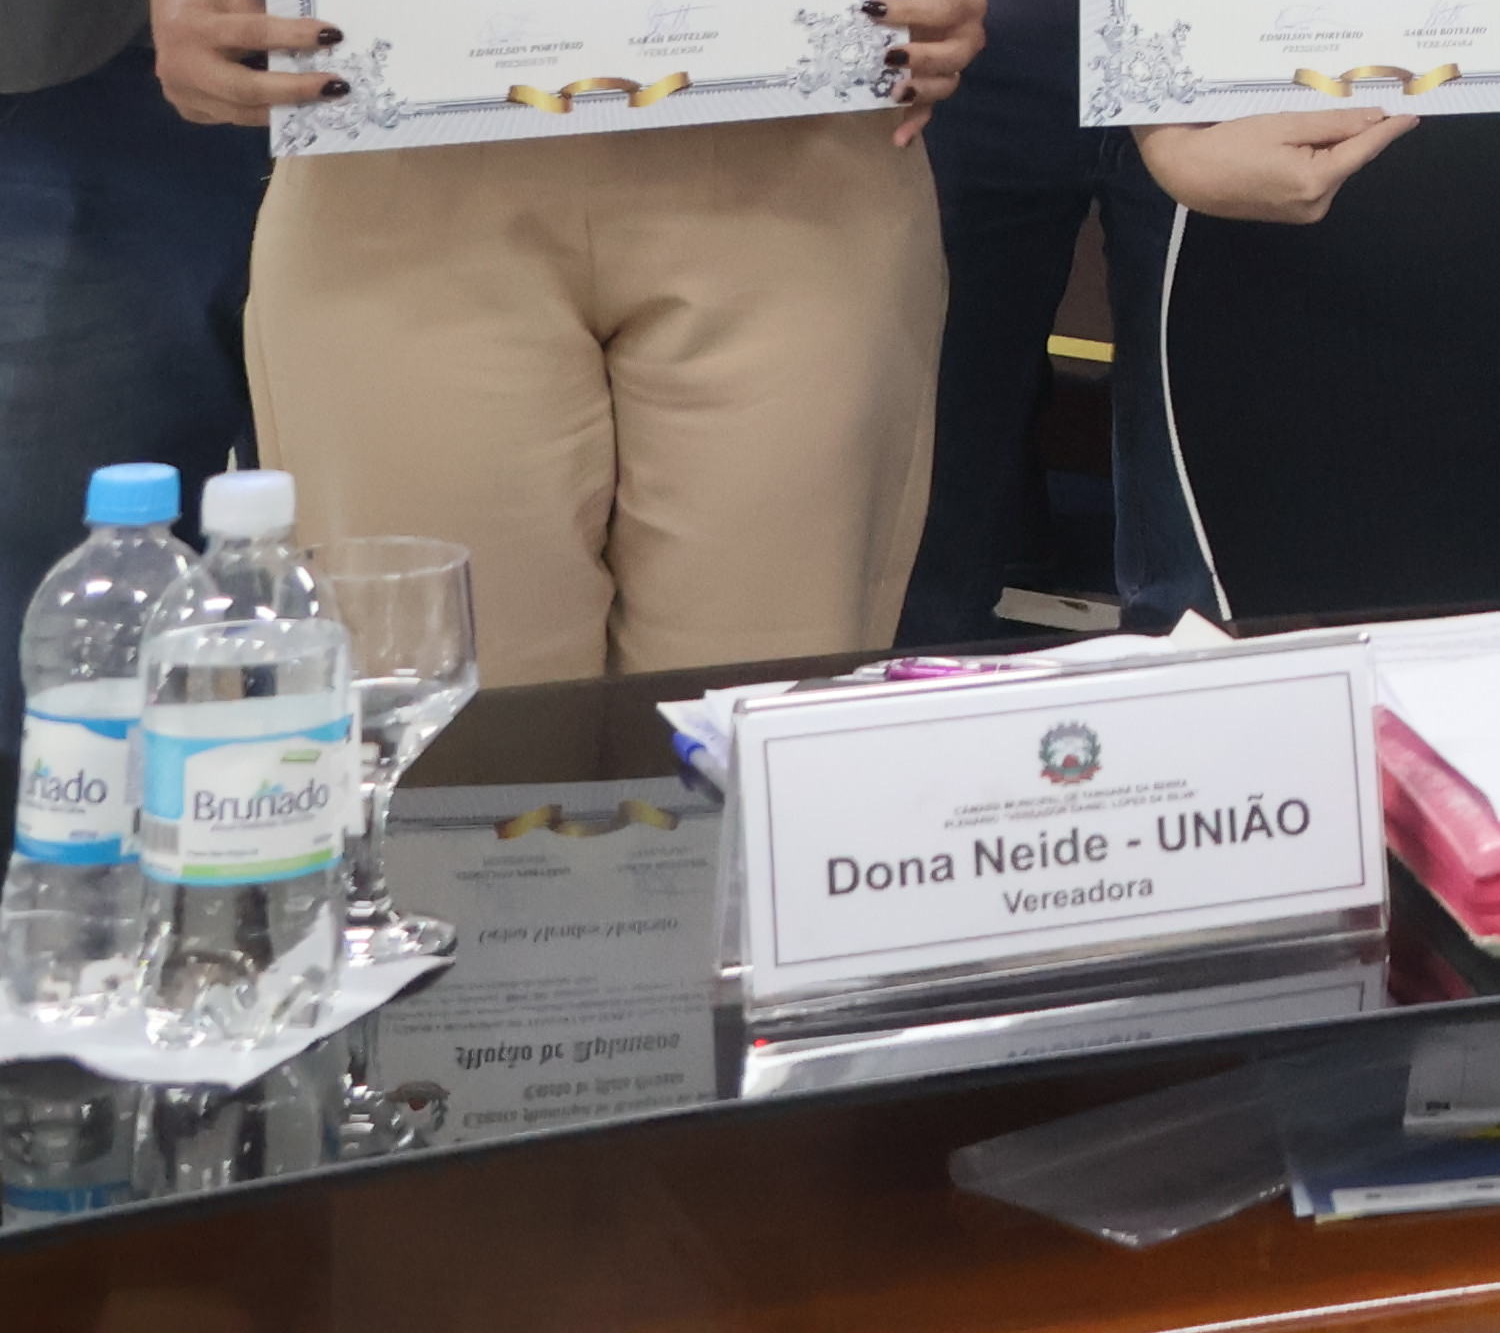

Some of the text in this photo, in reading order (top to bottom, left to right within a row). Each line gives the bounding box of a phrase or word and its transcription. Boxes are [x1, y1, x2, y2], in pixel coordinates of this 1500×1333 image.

[193, 777, 330, 822] Brunado
[827, 853, 955, 896] Dona
[974, 829, 1108, 875] Neide
[1157, 795, 1311, 854] UNIÃO
[1003, 875, 1154, 916] Vereadora
